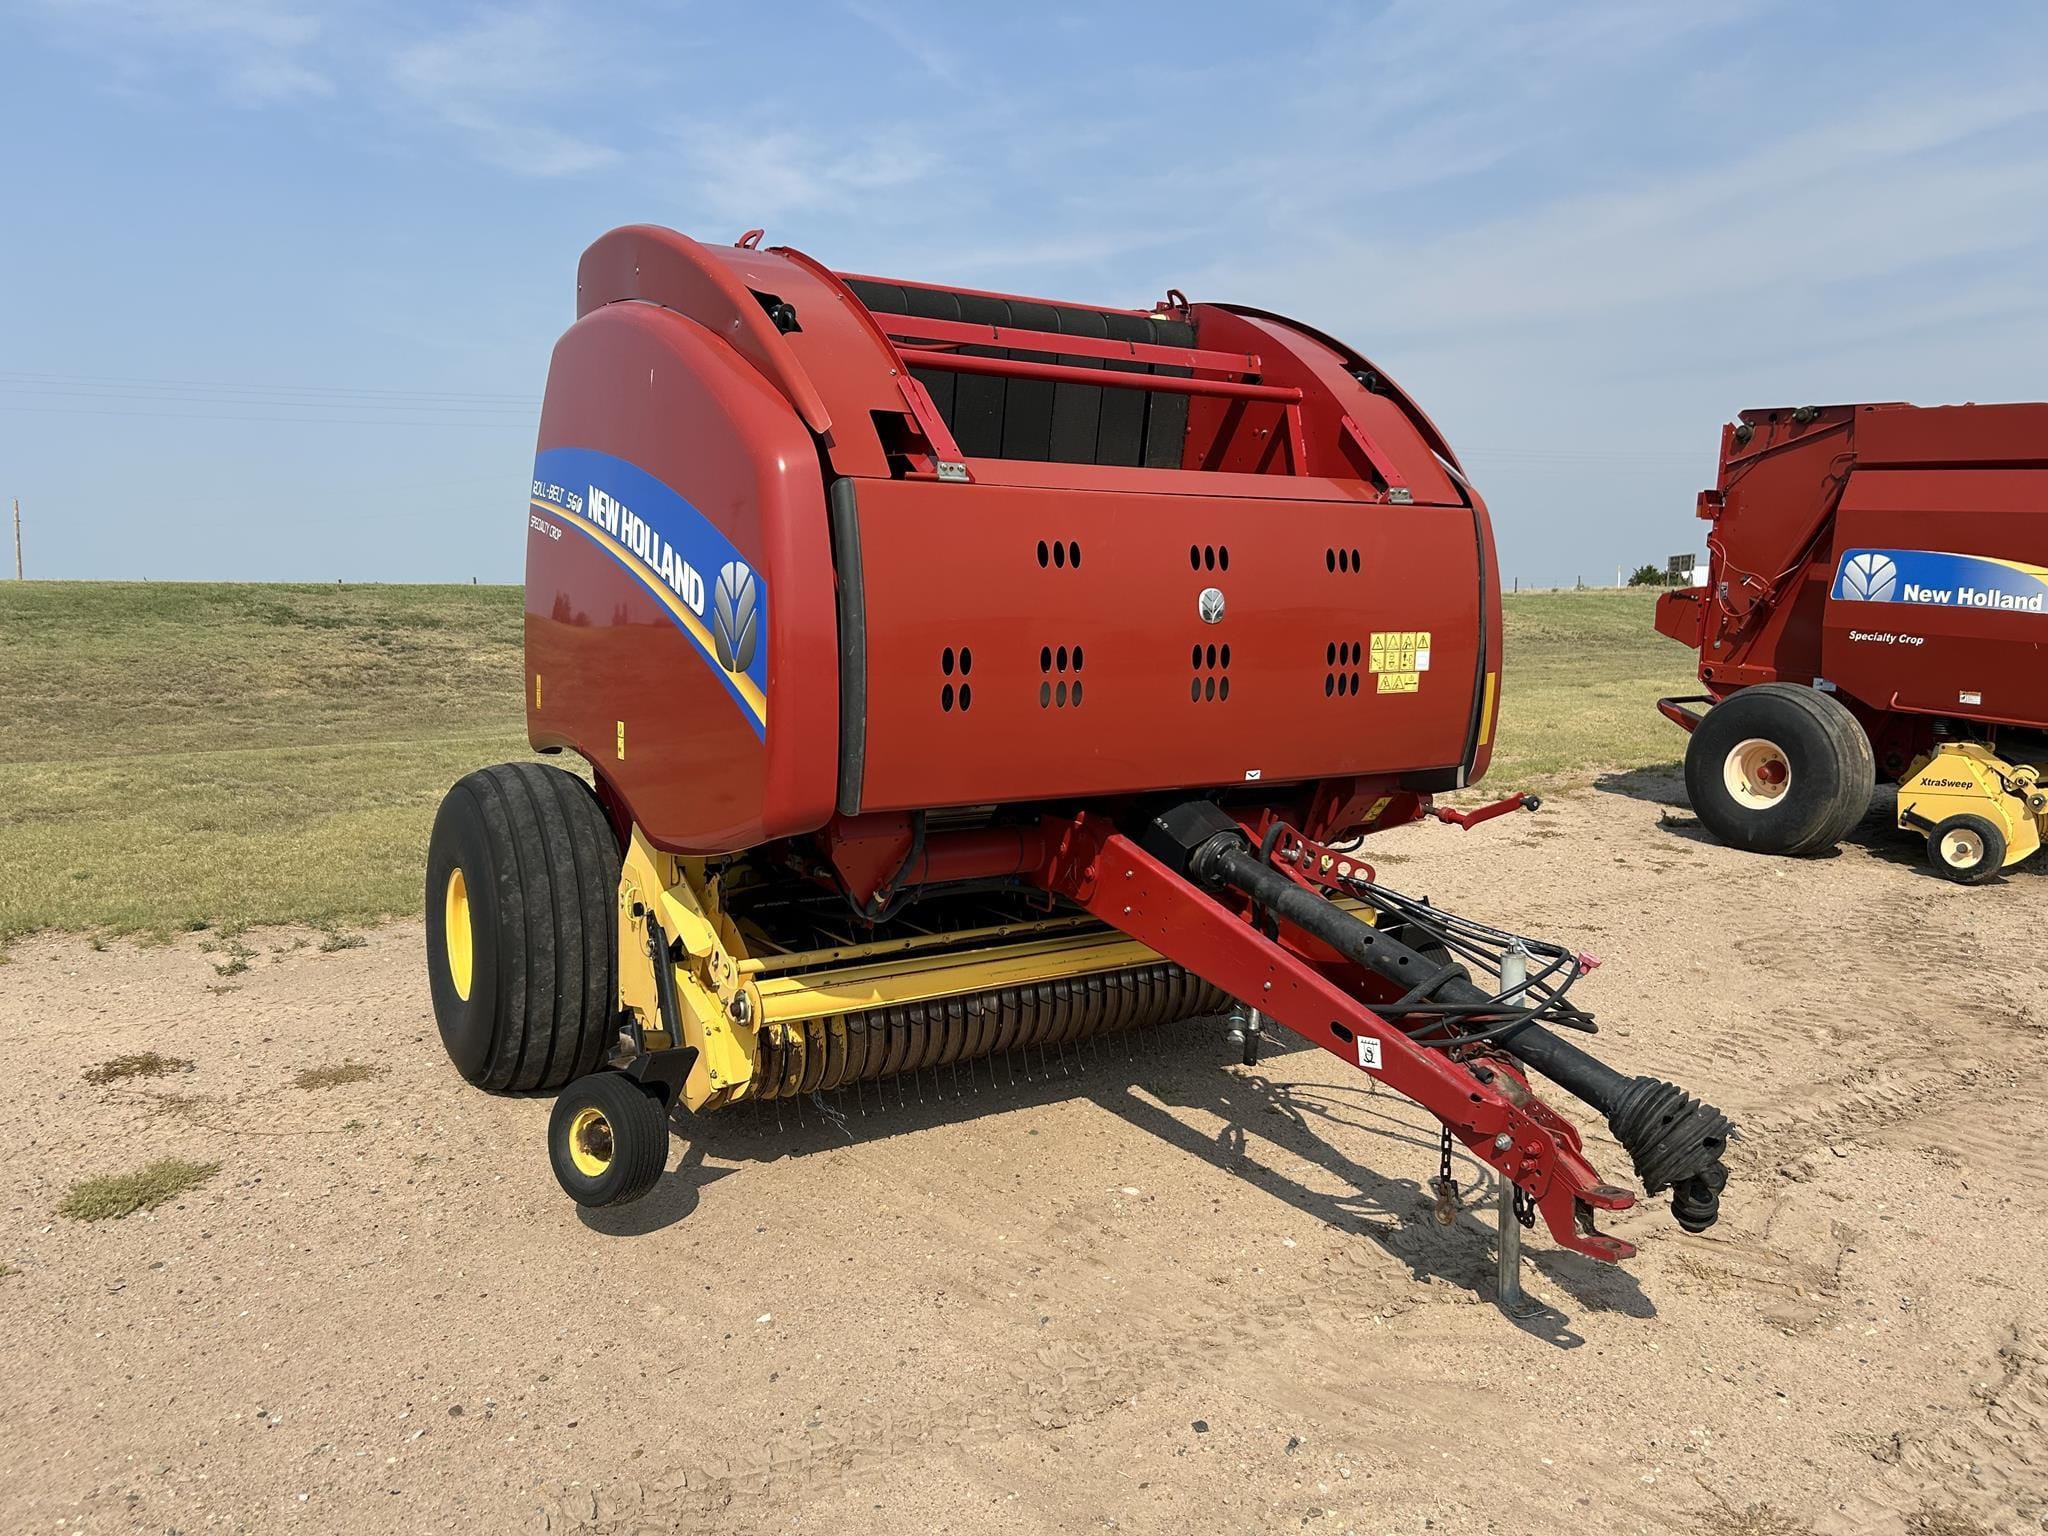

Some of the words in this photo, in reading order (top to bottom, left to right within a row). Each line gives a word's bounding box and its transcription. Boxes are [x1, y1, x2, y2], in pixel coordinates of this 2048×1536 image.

[565, 491, 583, 514] 560
[549, 525, 562, 541] CROP
[588, 484, 620, 537] NEW
[620, 505, 705, 617] HOLLAND
[1903, 583, 1951, 604] New
[1957, 587, 2043, 611] Holland
[1849, 630, 1896, 645] Specialty
[1898, 634, 1924, 645] Crop
[1920, 777, 1973, 790] XtraSweep
